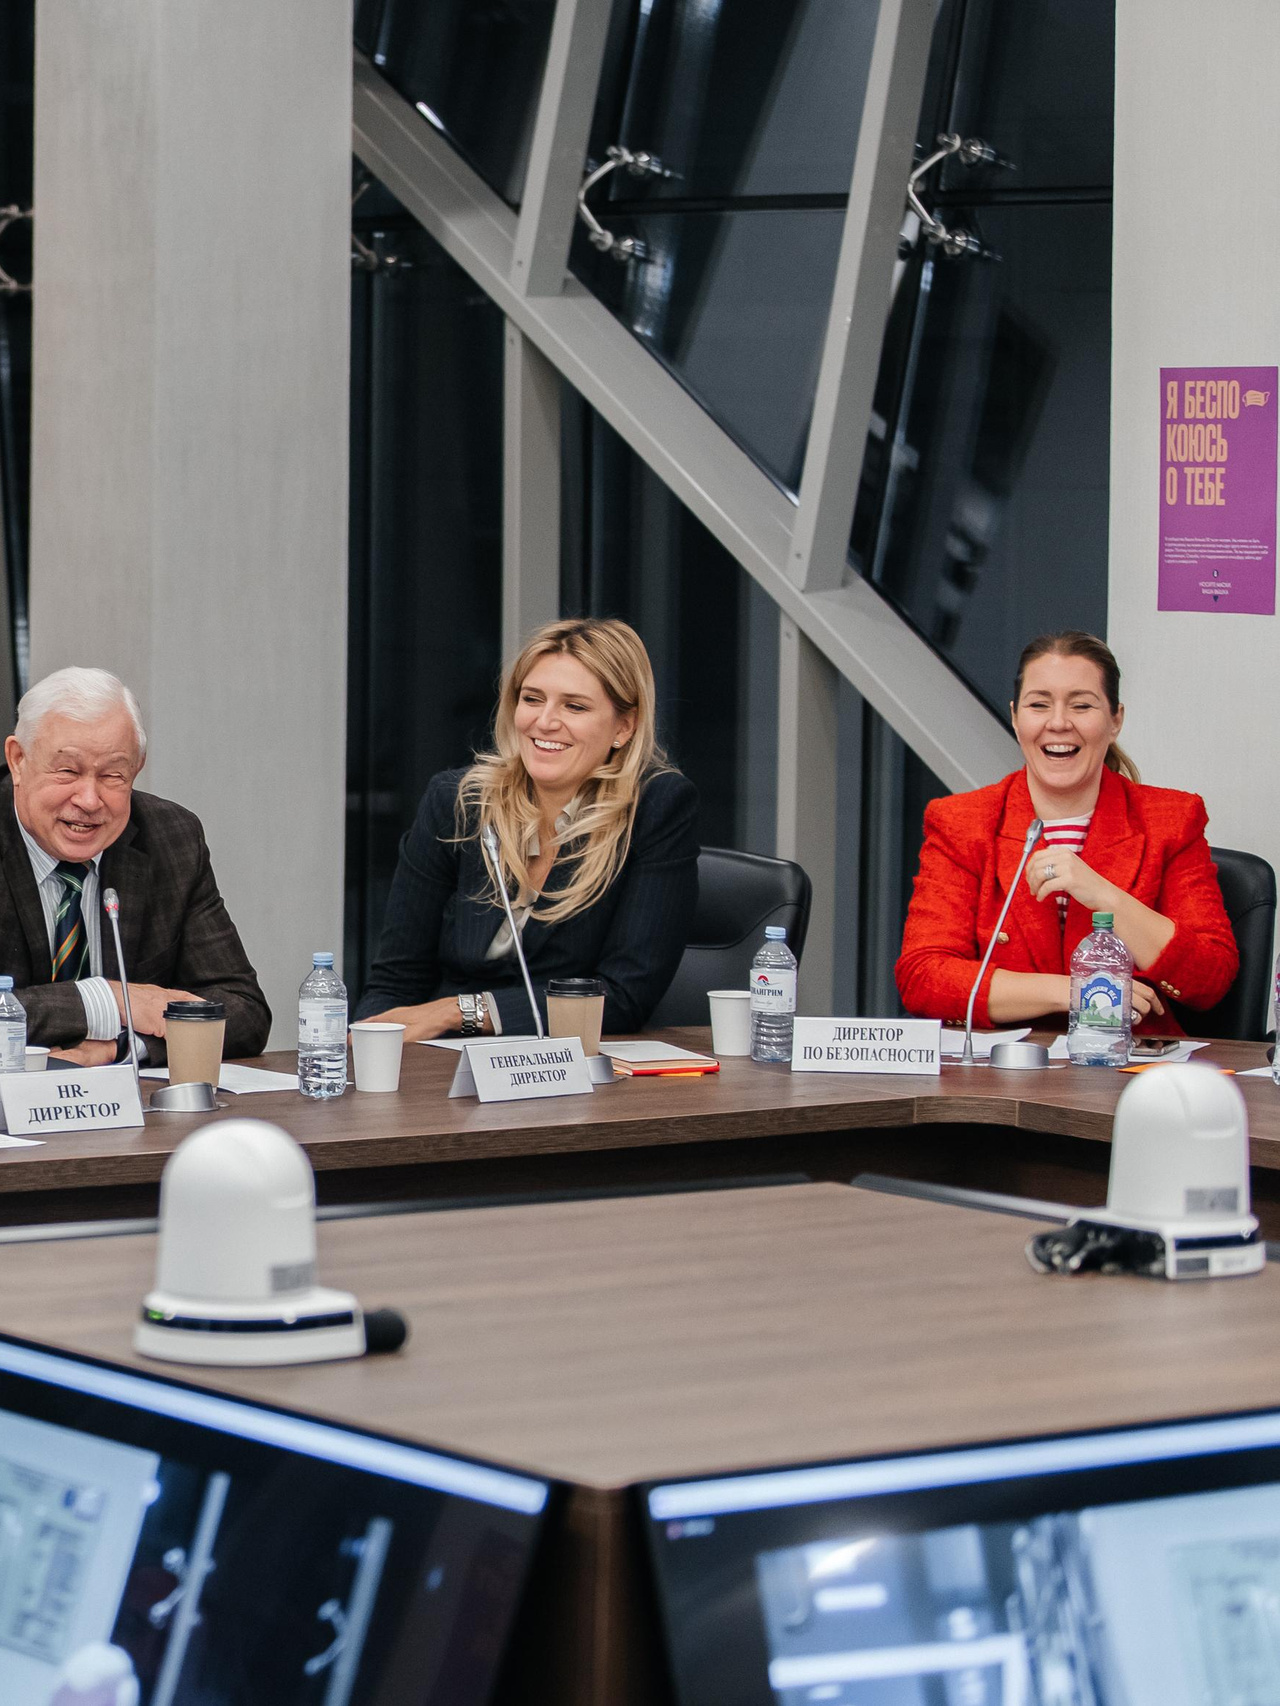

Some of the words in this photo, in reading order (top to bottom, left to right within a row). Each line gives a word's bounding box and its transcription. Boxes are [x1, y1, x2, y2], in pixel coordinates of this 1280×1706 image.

[1166, 381, 1178, 419] Я
[1184, 380, 1240, 419] БЕСПО
[1166, 424, 1228, 463] КОЮСЬ
[1166, 467, 1178, 506] О
[1183, 467, 1226, 506] ТЕБЕ
[832, 1026, 904, 1042] ДИРЕКТОР
[489, 1047, 574, 1069] ГЕНЕРАЛЬНЫЙ
[803, 1046, 823, 1060] ПО
[826, 1046, 935, 1063] БЕЗОПАСНОСТИ
[509, 1068, 567, 1087] ДИРЕКТОР
[57, 1083, 89, 1099] HR-
[28, 1102, 121, 1125] ДИРЕКТОР
